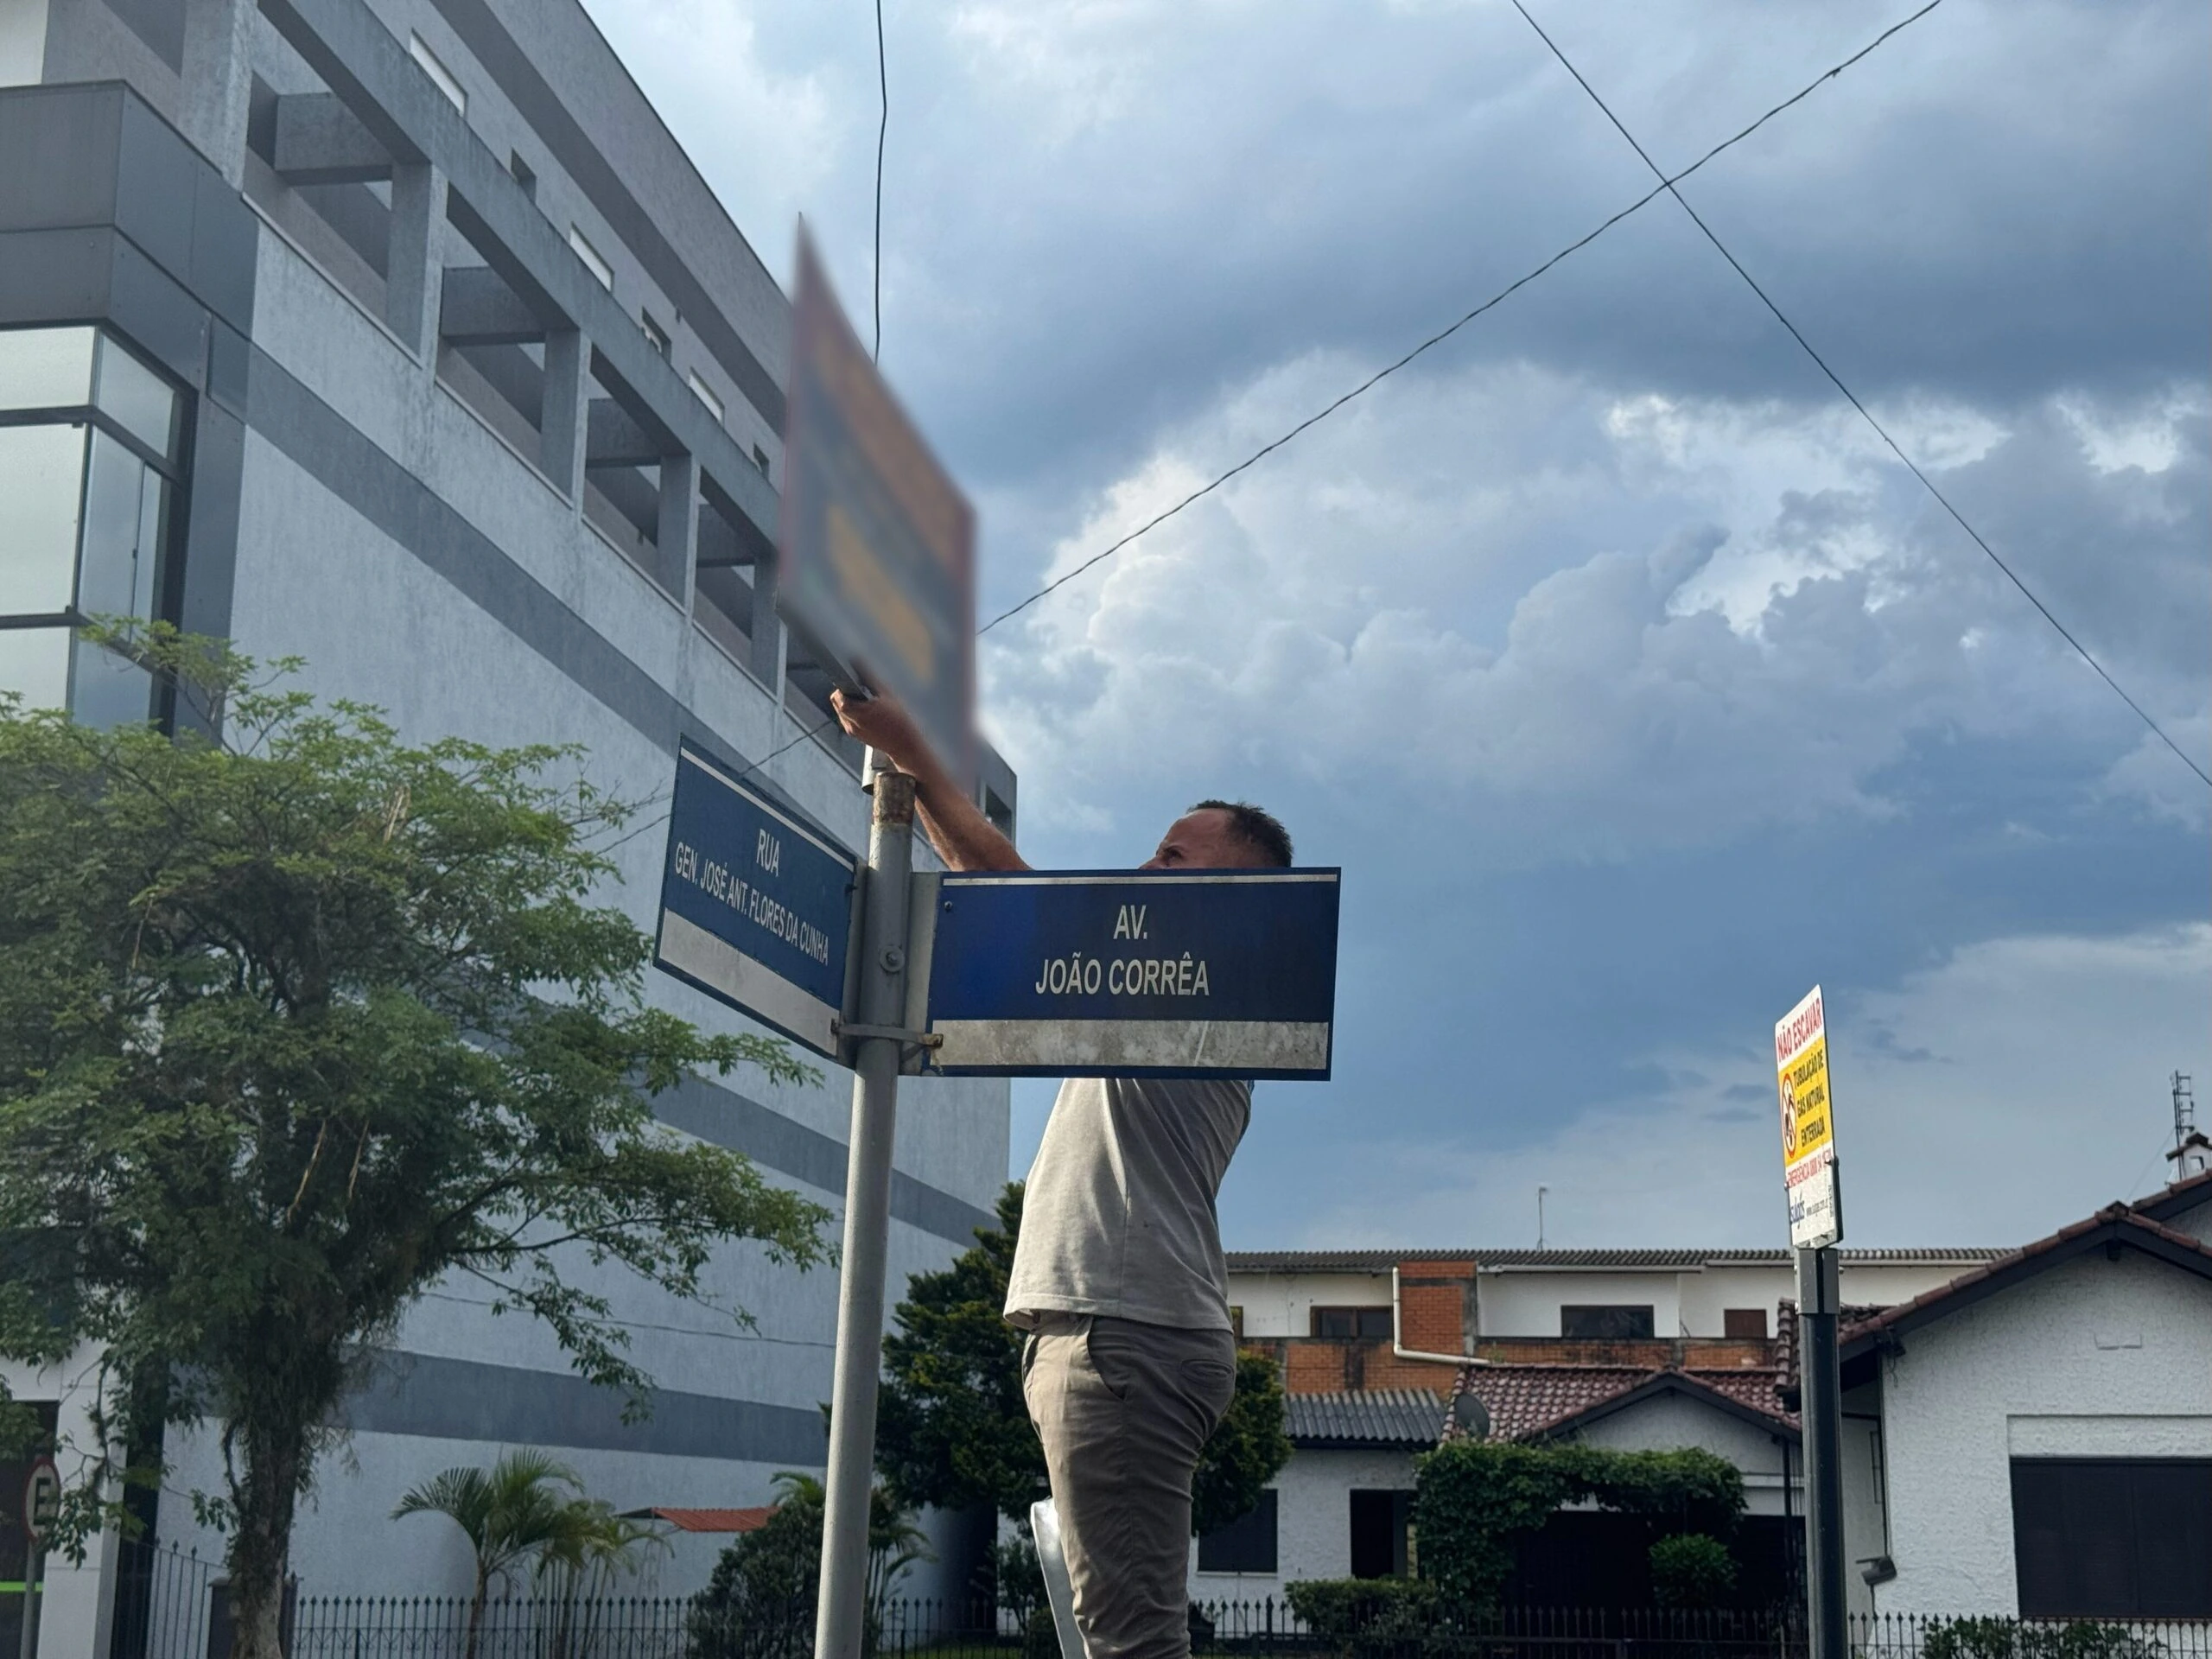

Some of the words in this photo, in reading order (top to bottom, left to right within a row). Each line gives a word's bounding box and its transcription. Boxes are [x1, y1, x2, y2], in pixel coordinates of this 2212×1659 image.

[756, 829, 779, 877] RUA
[675, 842, 698, 885] GEN.
[700, 860, 728, 901] JOSÉ
[727, 875, 748, 916] ANT.
[748, 888, 785, 938] FLORES
[785, 911, 798, 948] DA
[799, 921, 829, 966] CUNHA
[1113, 905, 1147, 940] AV.
[1035, 951, 1101, 996] JOÃO
[1109, 950, 1210, 996] CORRÊA
[1777, 1025, 1792, 1063] NÃO
[1793, 997, 1821, 1051] ESCAVAR
[1817, 1049, 1824, 1071] DE
[1806, 1082, 1825, 1113] NATURAL
[1802, 1116, 1825, 1147] ENTERRADA
[33, 1478, 53, 1525] E
